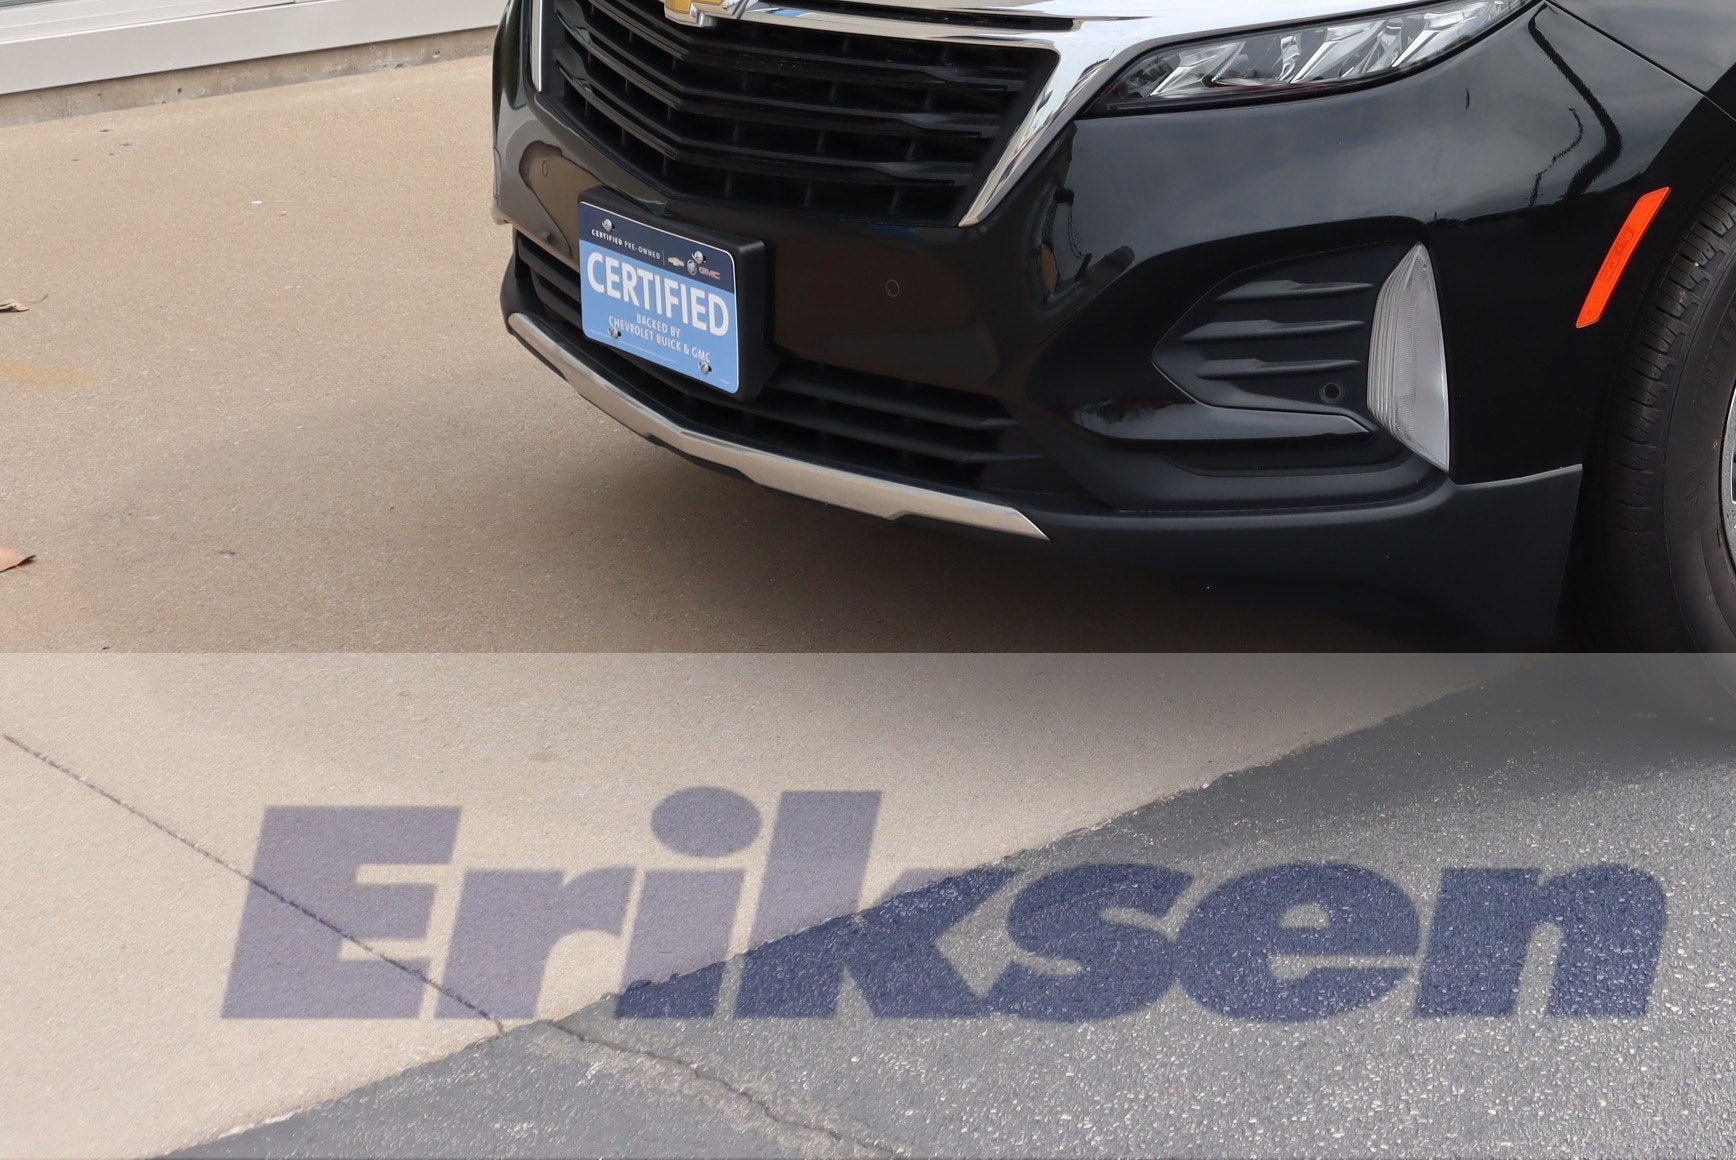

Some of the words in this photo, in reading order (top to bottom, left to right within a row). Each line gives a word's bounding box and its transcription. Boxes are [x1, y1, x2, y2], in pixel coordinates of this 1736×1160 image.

[591, 228, 623, 246] CERTIFIED
[624, 241, 661, 260] PRE-OWNED
[587, 251, 729, 337] CERTIFIED
[608, 315, 654, 342] CHEVROLET
[656, 334, 682, 352] BUICK
[692, 346, 711, 363] GMC
[636, 313, 668, 334] BACKED
[670, 326, 681, 338] BY
